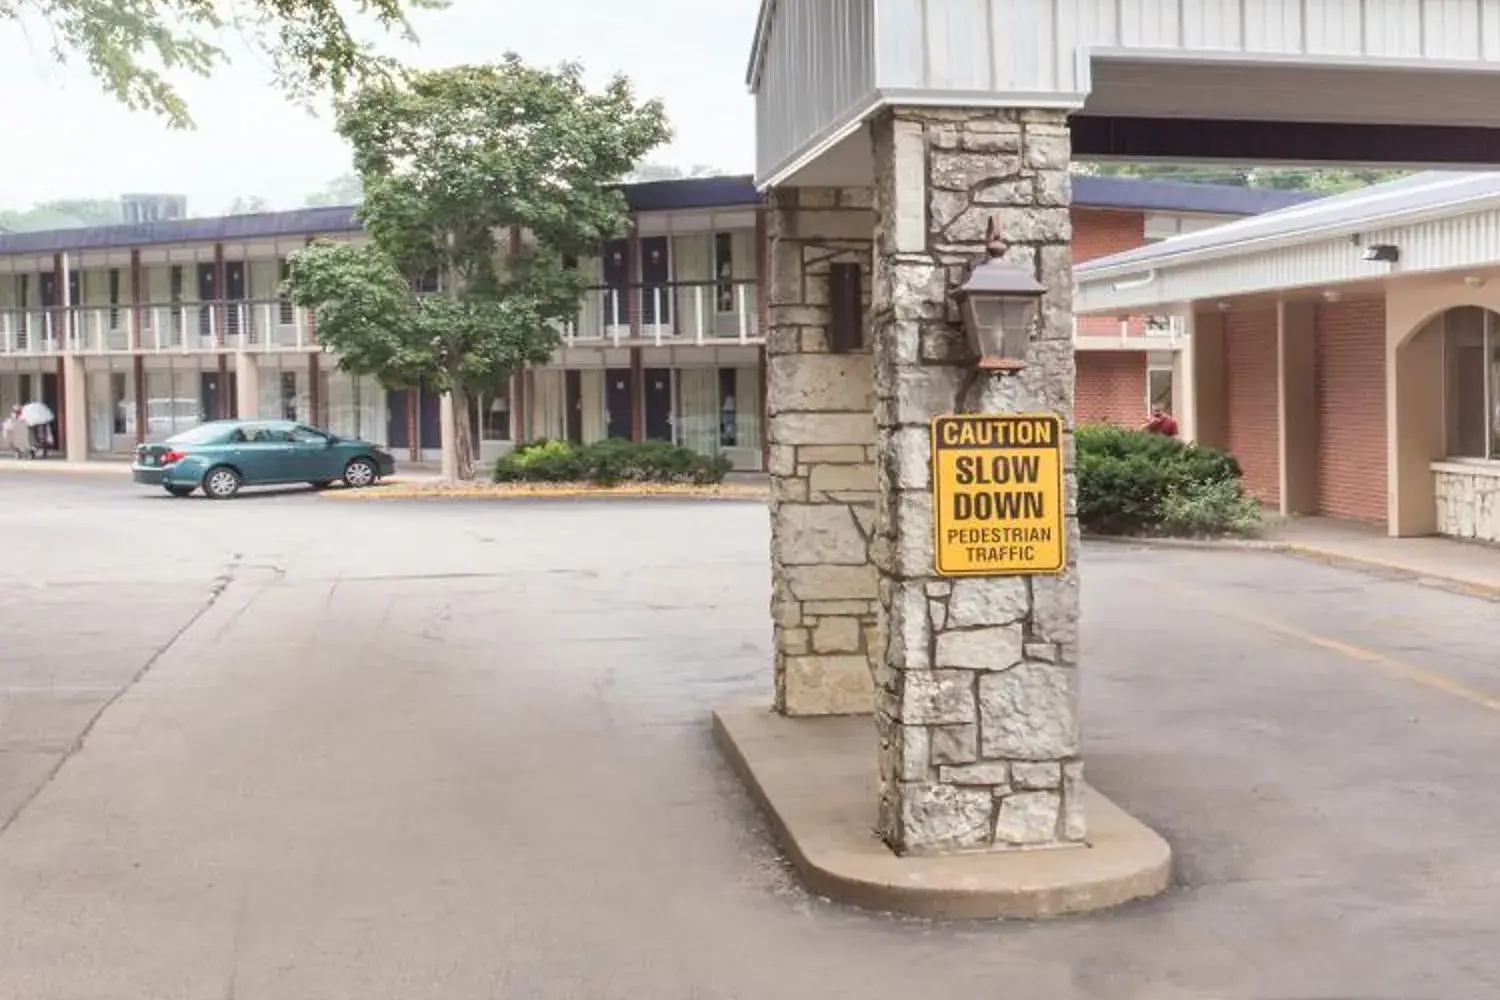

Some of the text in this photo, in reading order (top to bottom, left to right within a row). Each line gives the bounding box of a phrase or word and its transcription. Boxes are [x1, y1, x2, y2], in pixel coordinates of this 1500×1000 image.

[943, 421, 1052, 444] CAUTION
[955, 455, 1040, 485] SLOW
[953, 491, 1044, 520] DOWN
[947, 527, 1052, 544] PEDESTRIAN
[966, 545, 1035, 562] TRAFFIC
